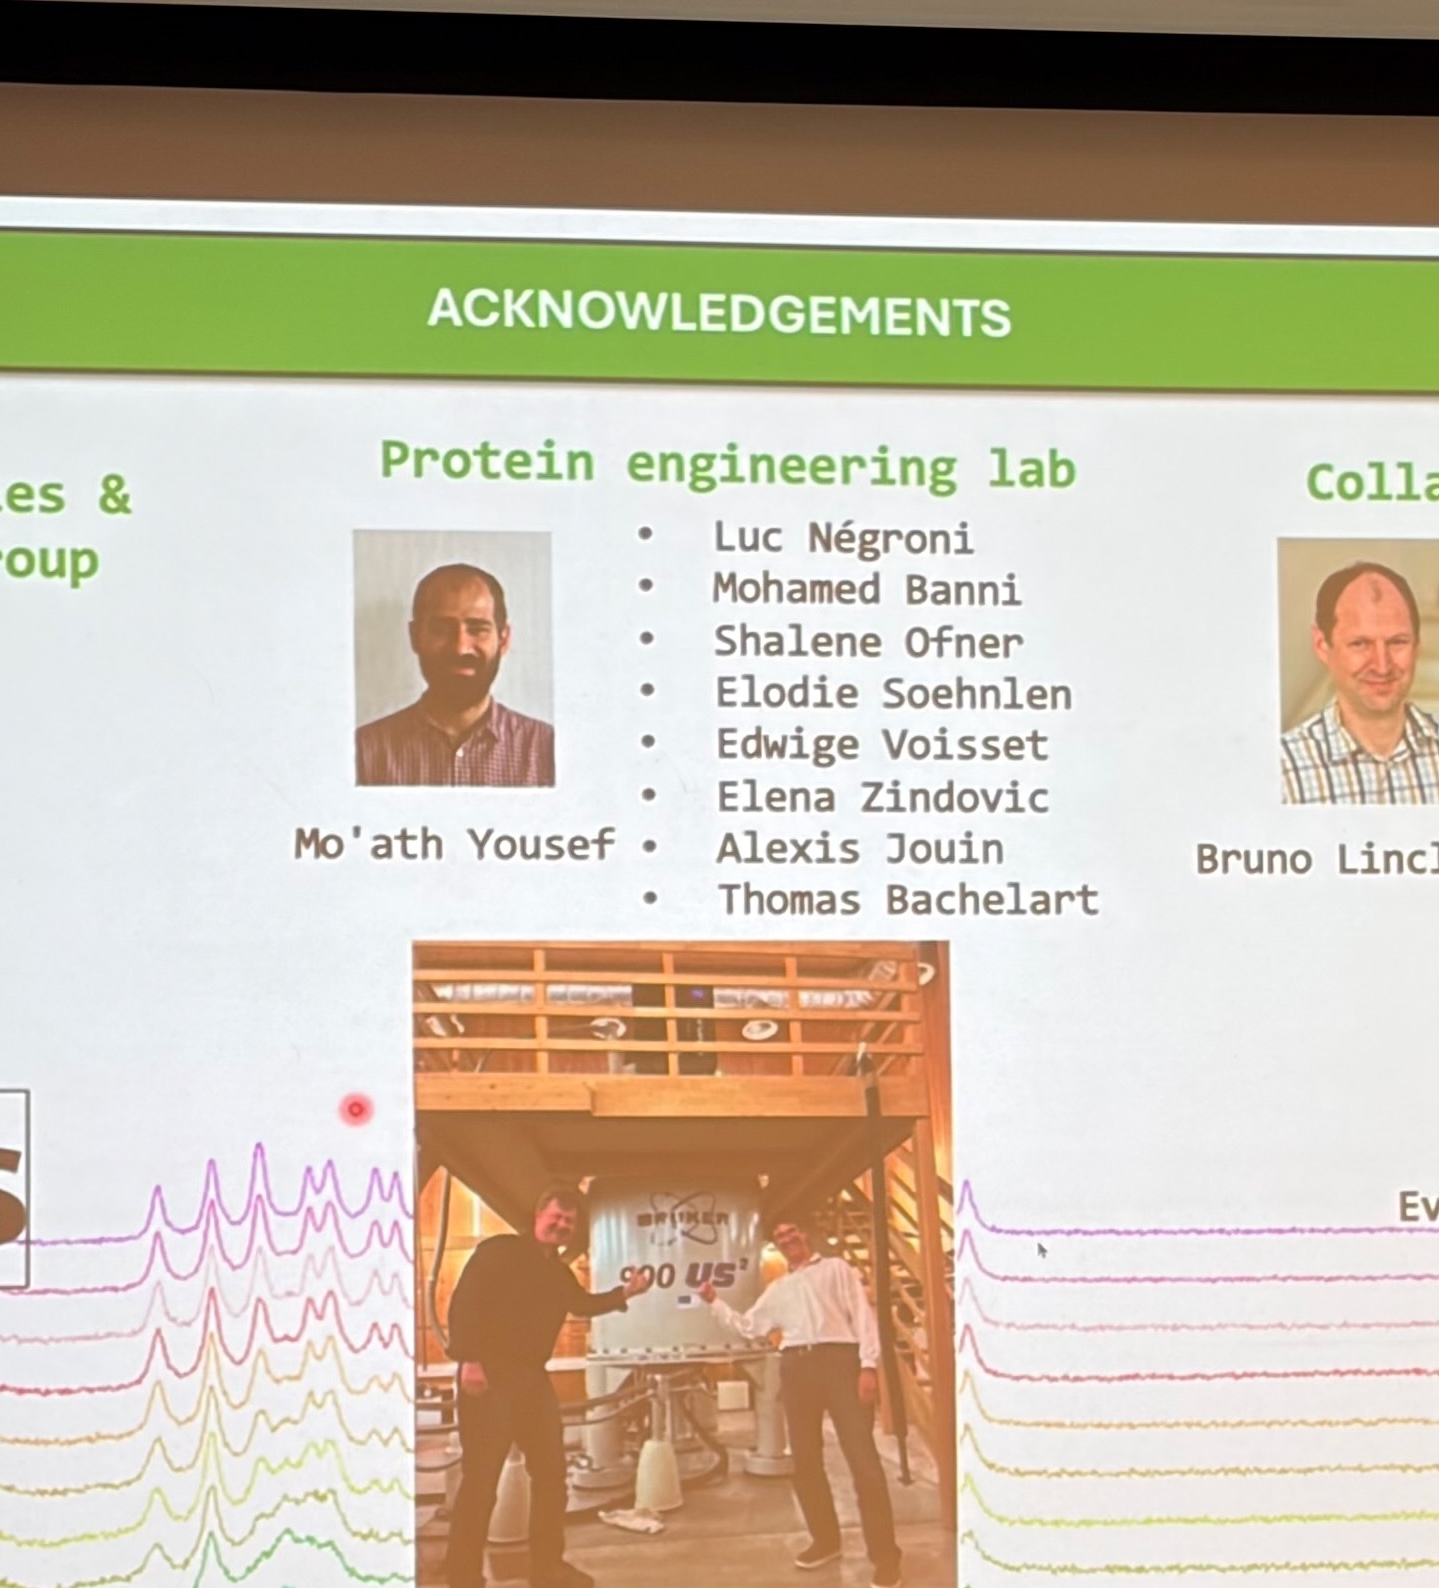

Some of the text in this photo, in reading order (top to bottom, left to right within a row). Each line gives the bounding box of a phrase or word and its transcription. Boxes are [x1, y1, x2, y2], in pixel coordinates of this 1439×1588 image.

[428, 288, 1011, 337] ACKNOWLEDGEMENTS
[383, 440, 1075, 497] Protein engineering lab
[0, 474, 131, 515] es &
[716, 519, 974, 562] Luc Négroni
[0, 546, 99, 589] oup
[713, 570, 1022, 606] Mohamed Banni
[715, 623, 1024, 659] Shalene Ofner
[717, 674, 1072, 710] Elodie Soehnlen
[718, 725, 1048, 768] Edwige Voisset
[719, 779, 1048, 813] Elena Zindovic
[295, 825, 615, 860] Mo'ath Yousef
[716, 830, 1003, 864] Alexis Jouin
[1197, 843, 1312, 874] Bruno
[718, 881, 1099, 915] Thomas Bachelart
